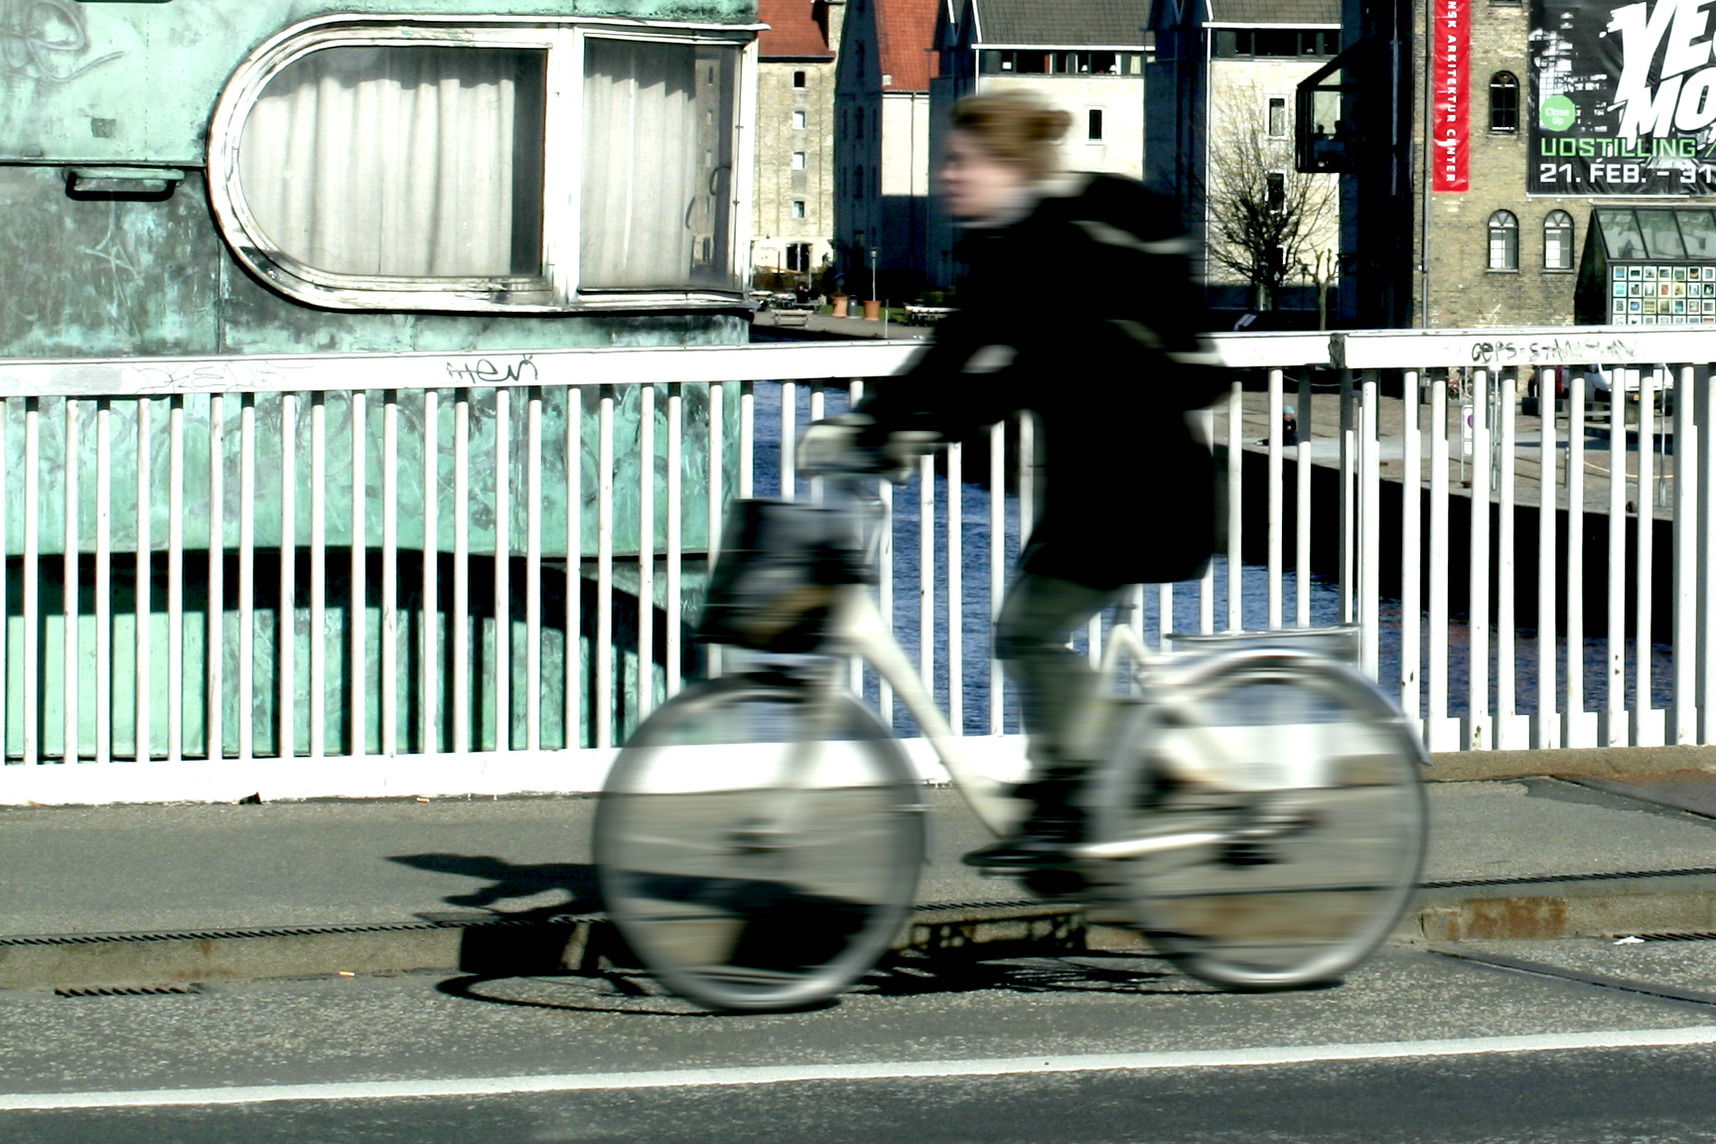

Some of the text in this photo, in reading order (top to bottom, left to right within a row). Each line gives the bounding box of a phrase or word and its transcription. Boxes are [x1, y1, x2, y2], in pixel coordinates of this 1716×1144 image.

[1446, 35, 1457, 122] ARKITEKTUR
[1541, 138, 1697, 158] UDSTILLING
[1540, 163, 1581, 183] 21.
[1590, 164, 1647, 184] FEB.
